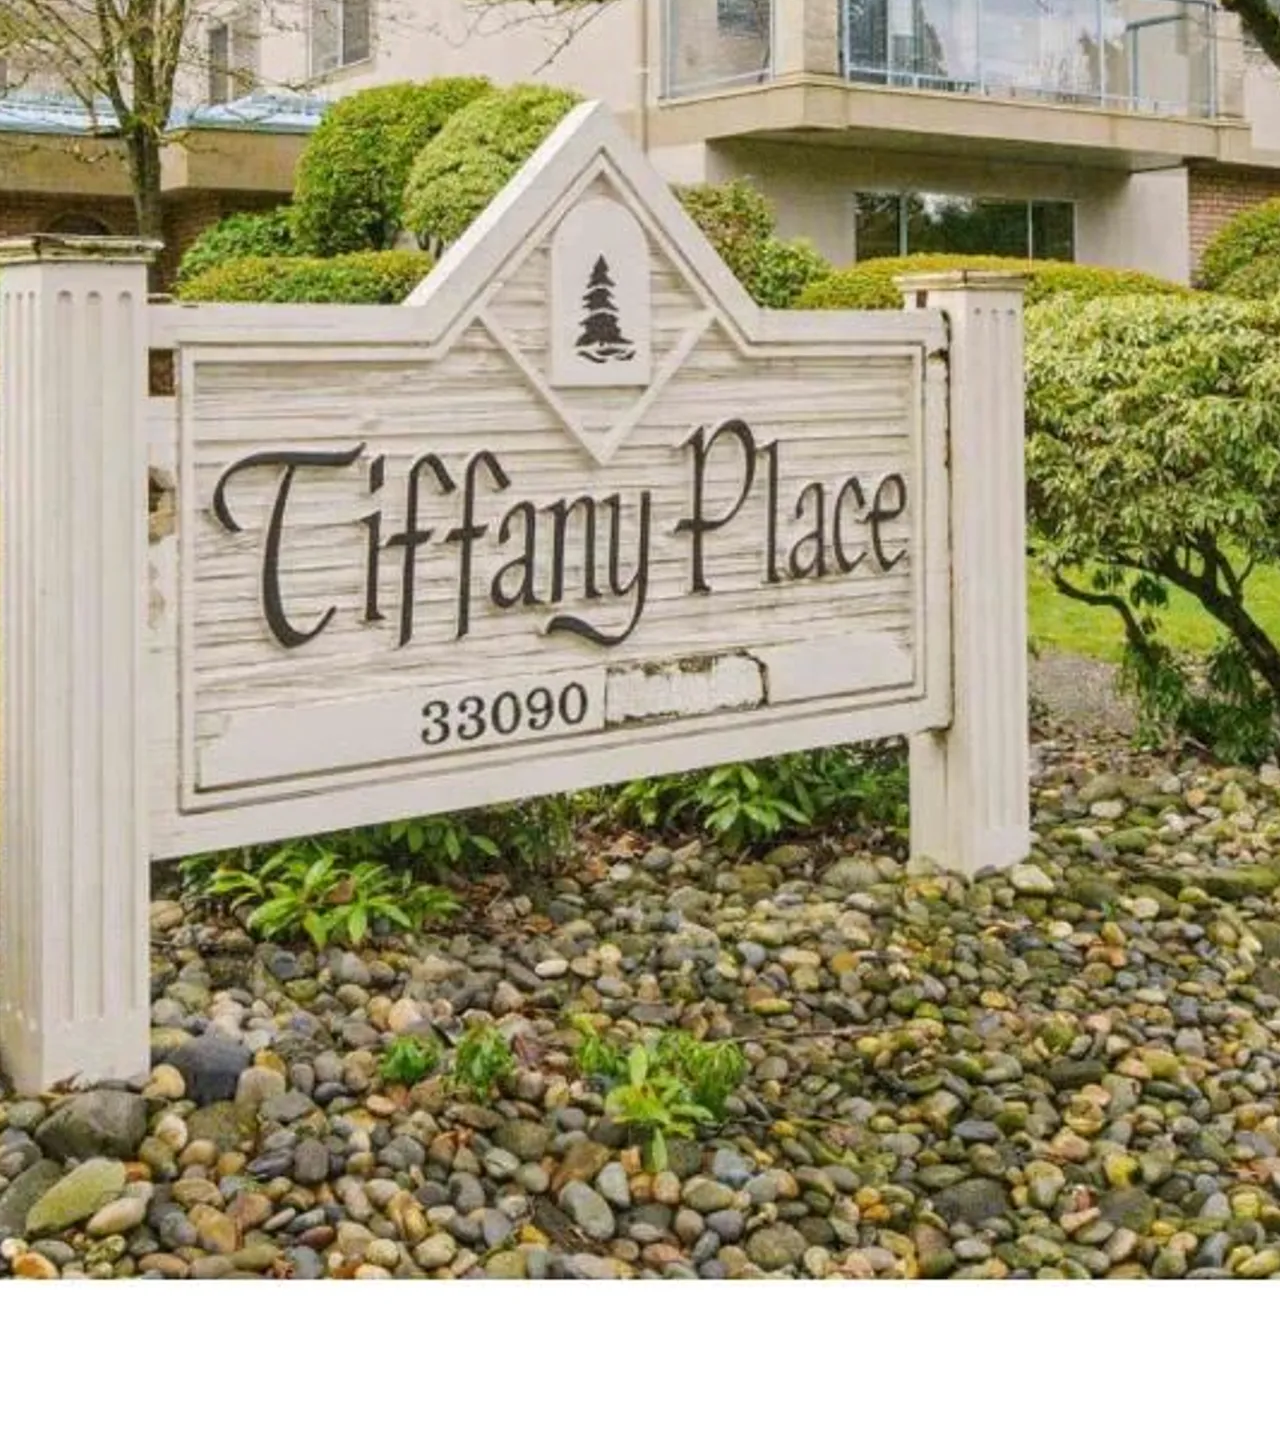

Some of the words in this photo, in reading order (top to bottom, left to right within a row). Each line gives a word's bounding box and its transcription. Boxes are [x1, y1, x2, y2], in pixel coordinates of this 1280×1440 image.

[212, 441, 652, 649] Tiffany
[673, 418, 907, 595] Place
[419, 681, 589, 745] 33090
